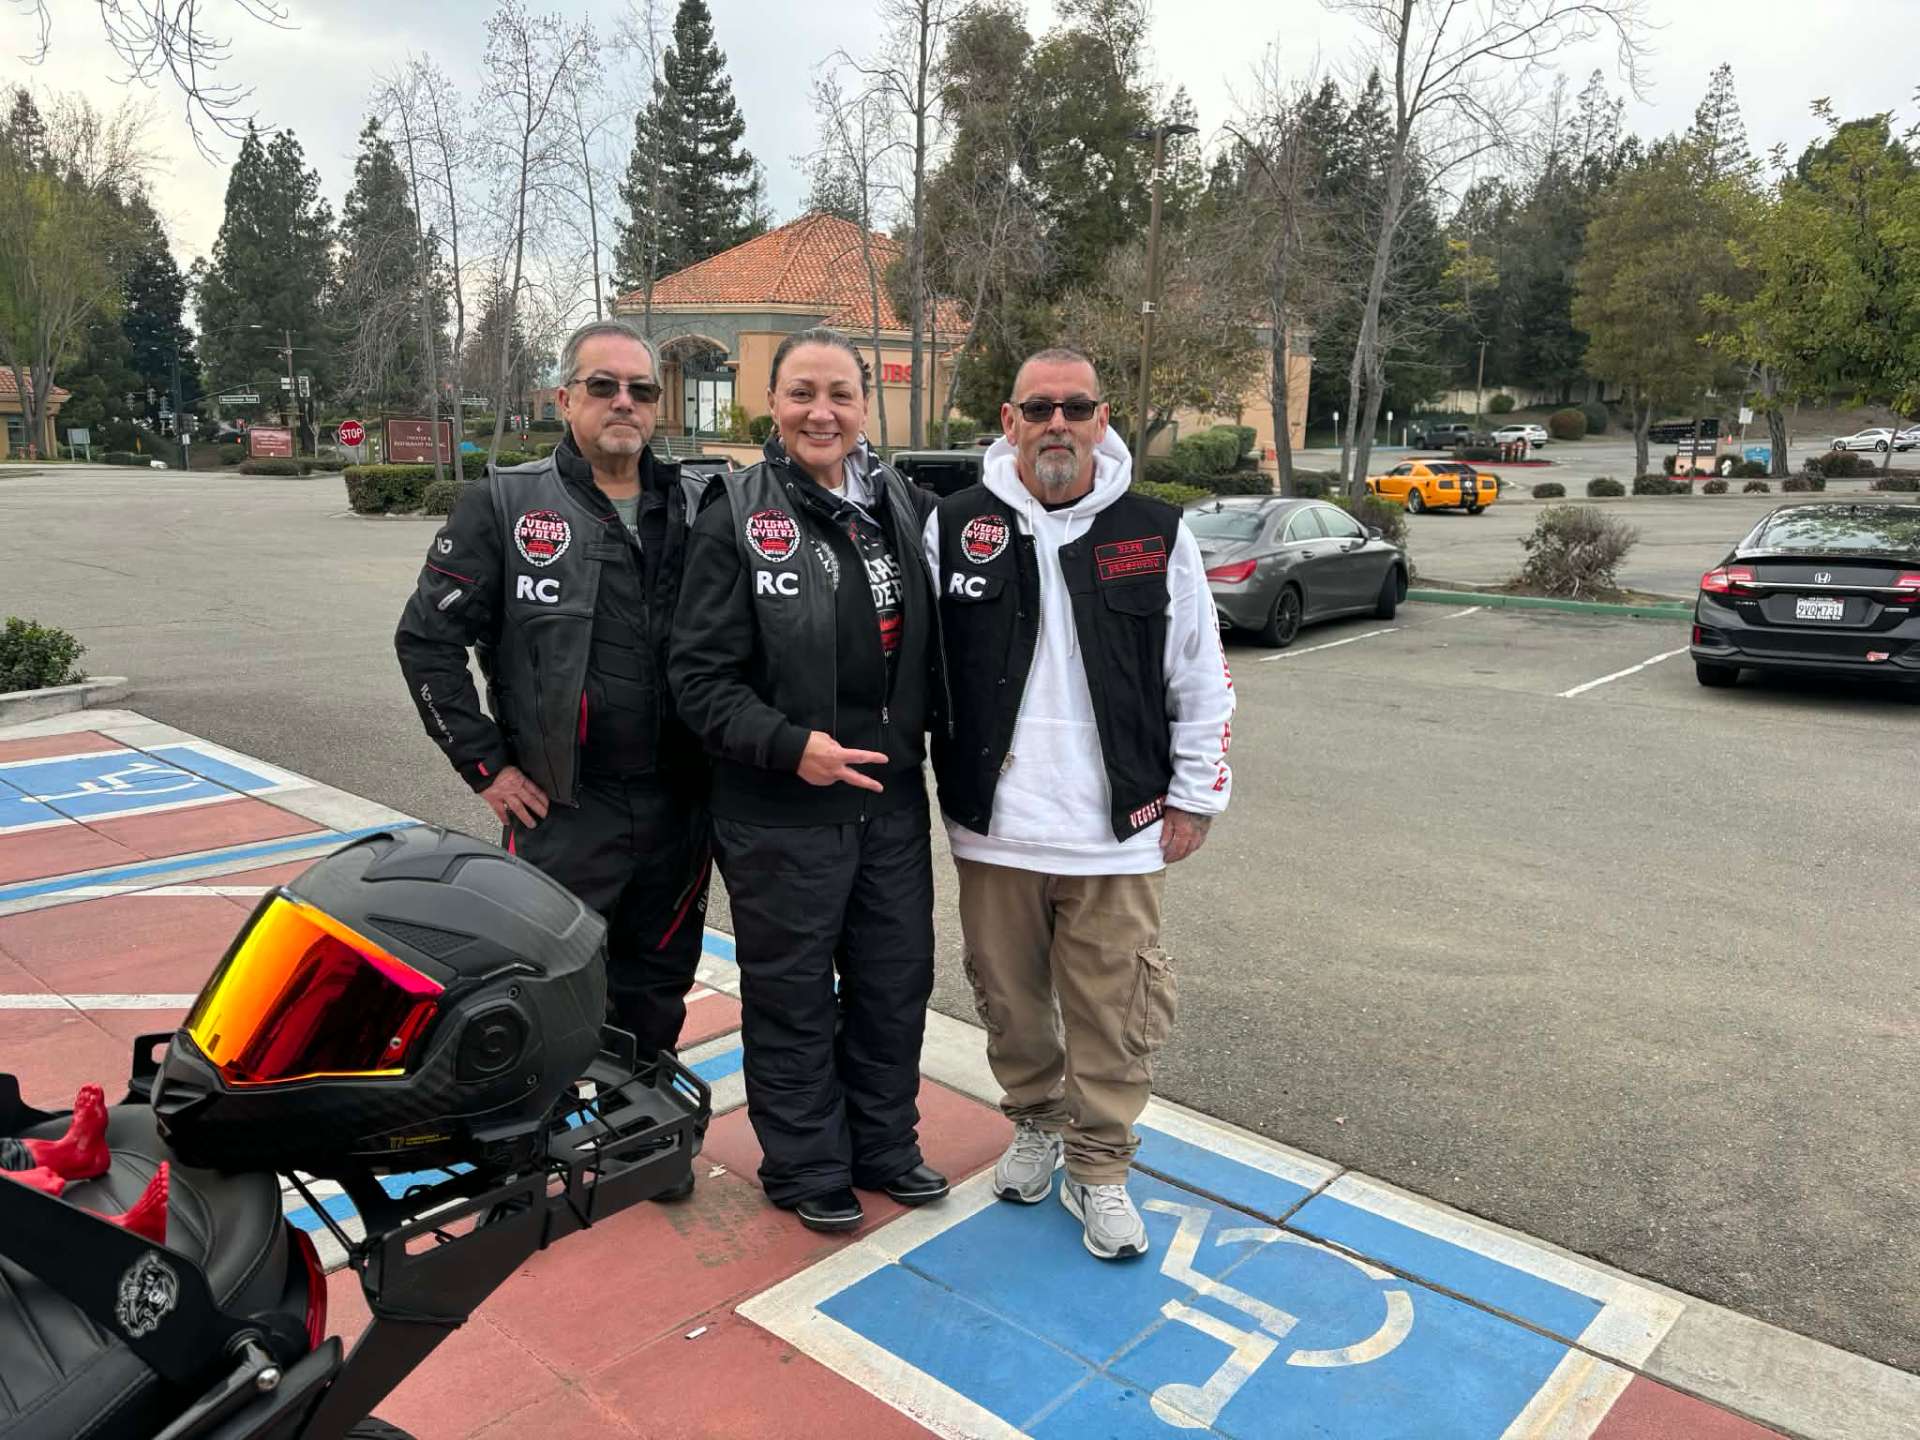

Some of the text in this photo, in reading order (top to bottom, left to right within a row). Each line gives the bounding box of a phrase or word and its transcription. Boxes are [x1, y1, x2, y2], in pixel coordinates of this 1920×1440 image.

[340, 428, 363, 440] STOP
[525, 518, 563, 532] VEGAS
[754, 519, 791, 529] VEGAS
[973, 522, 1005, 536] VEGAS
[520, 527, 566, 541] RYDERZ
[751, 528, 796, 538] RYDERZ
[966, 529, 1005, 544] RYDERZ
[516, 574, 560, 603] RC
[757, 570, 799, 595] RC
[949, 572, 986, 598] RC
[1130, 802, 1157, 828] VEGAS
